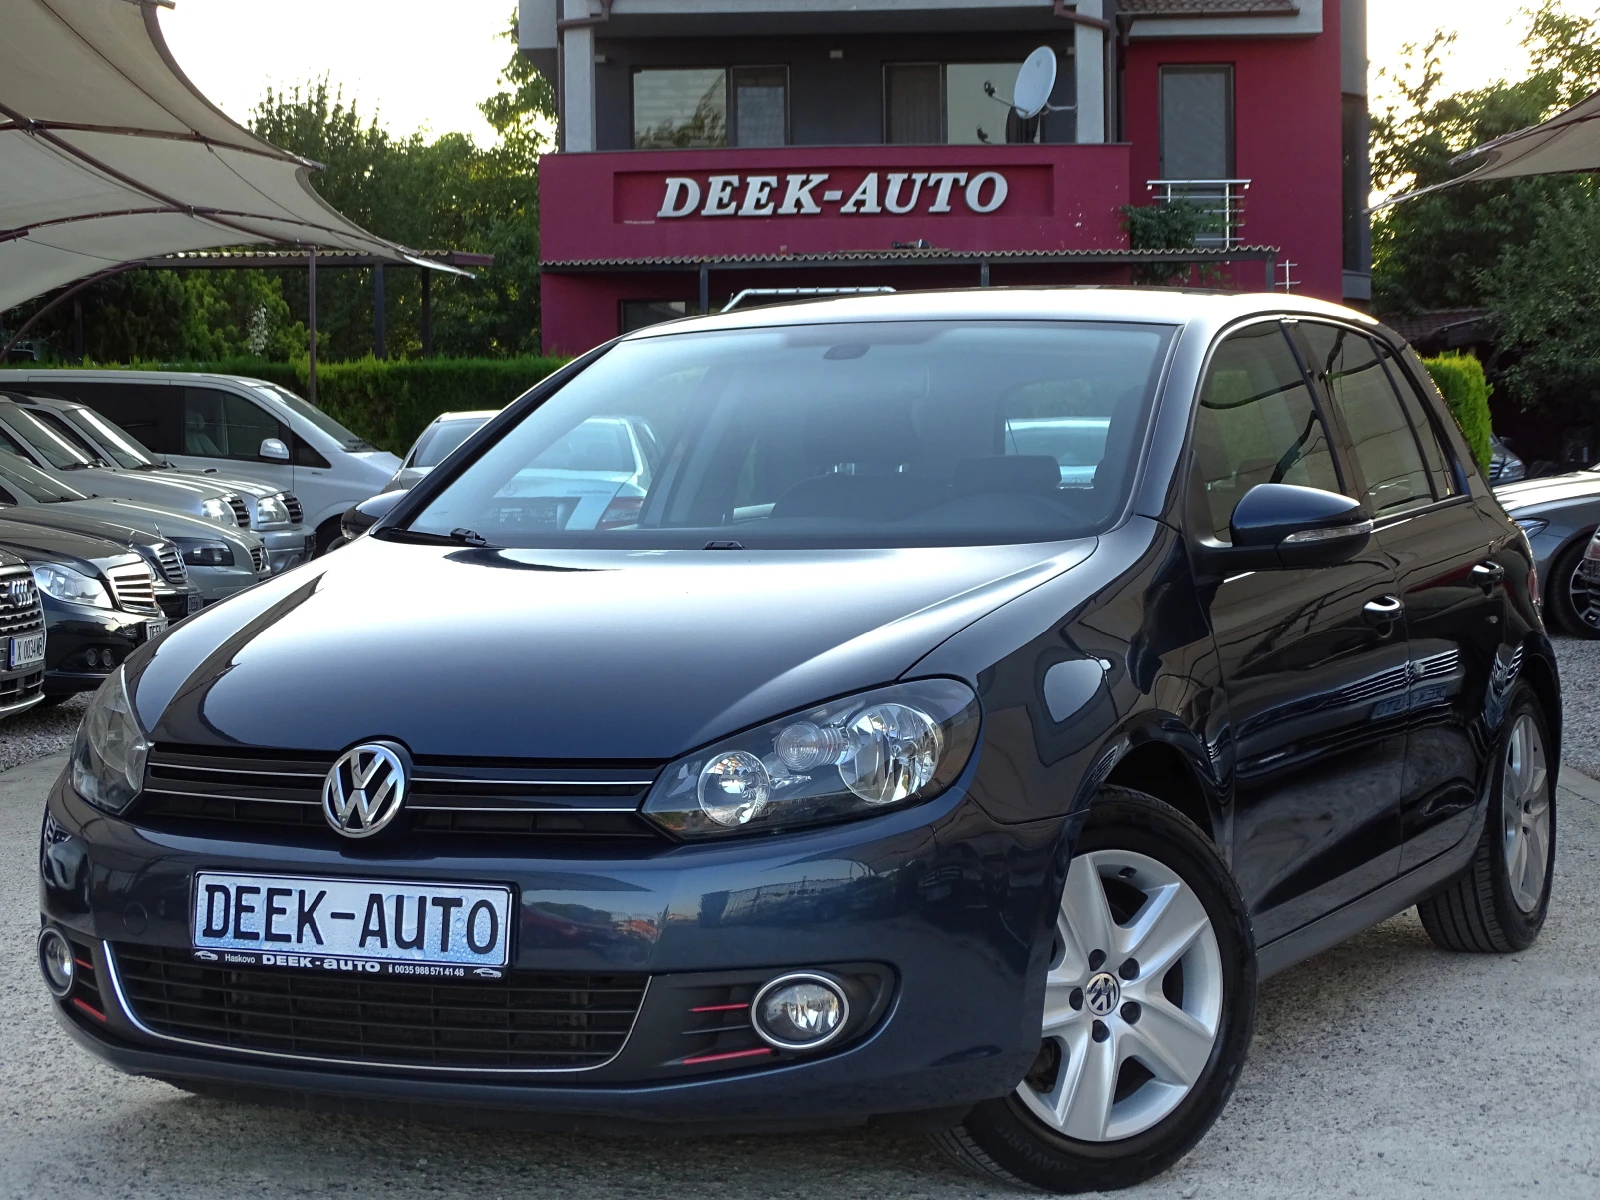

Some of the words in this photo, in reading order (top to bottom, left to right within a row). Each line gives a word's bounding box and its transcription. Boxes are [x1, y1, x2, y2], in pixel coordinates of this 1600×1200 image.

[656, 170, 1009, 218] DEEK-AUTO
[202, 884, 499, 954] DEEK-AUTO
[224, 953, 256, 964] Haskovo
[394, 965, 414, 975] 0035
[415, 966, 430, 976] 988
